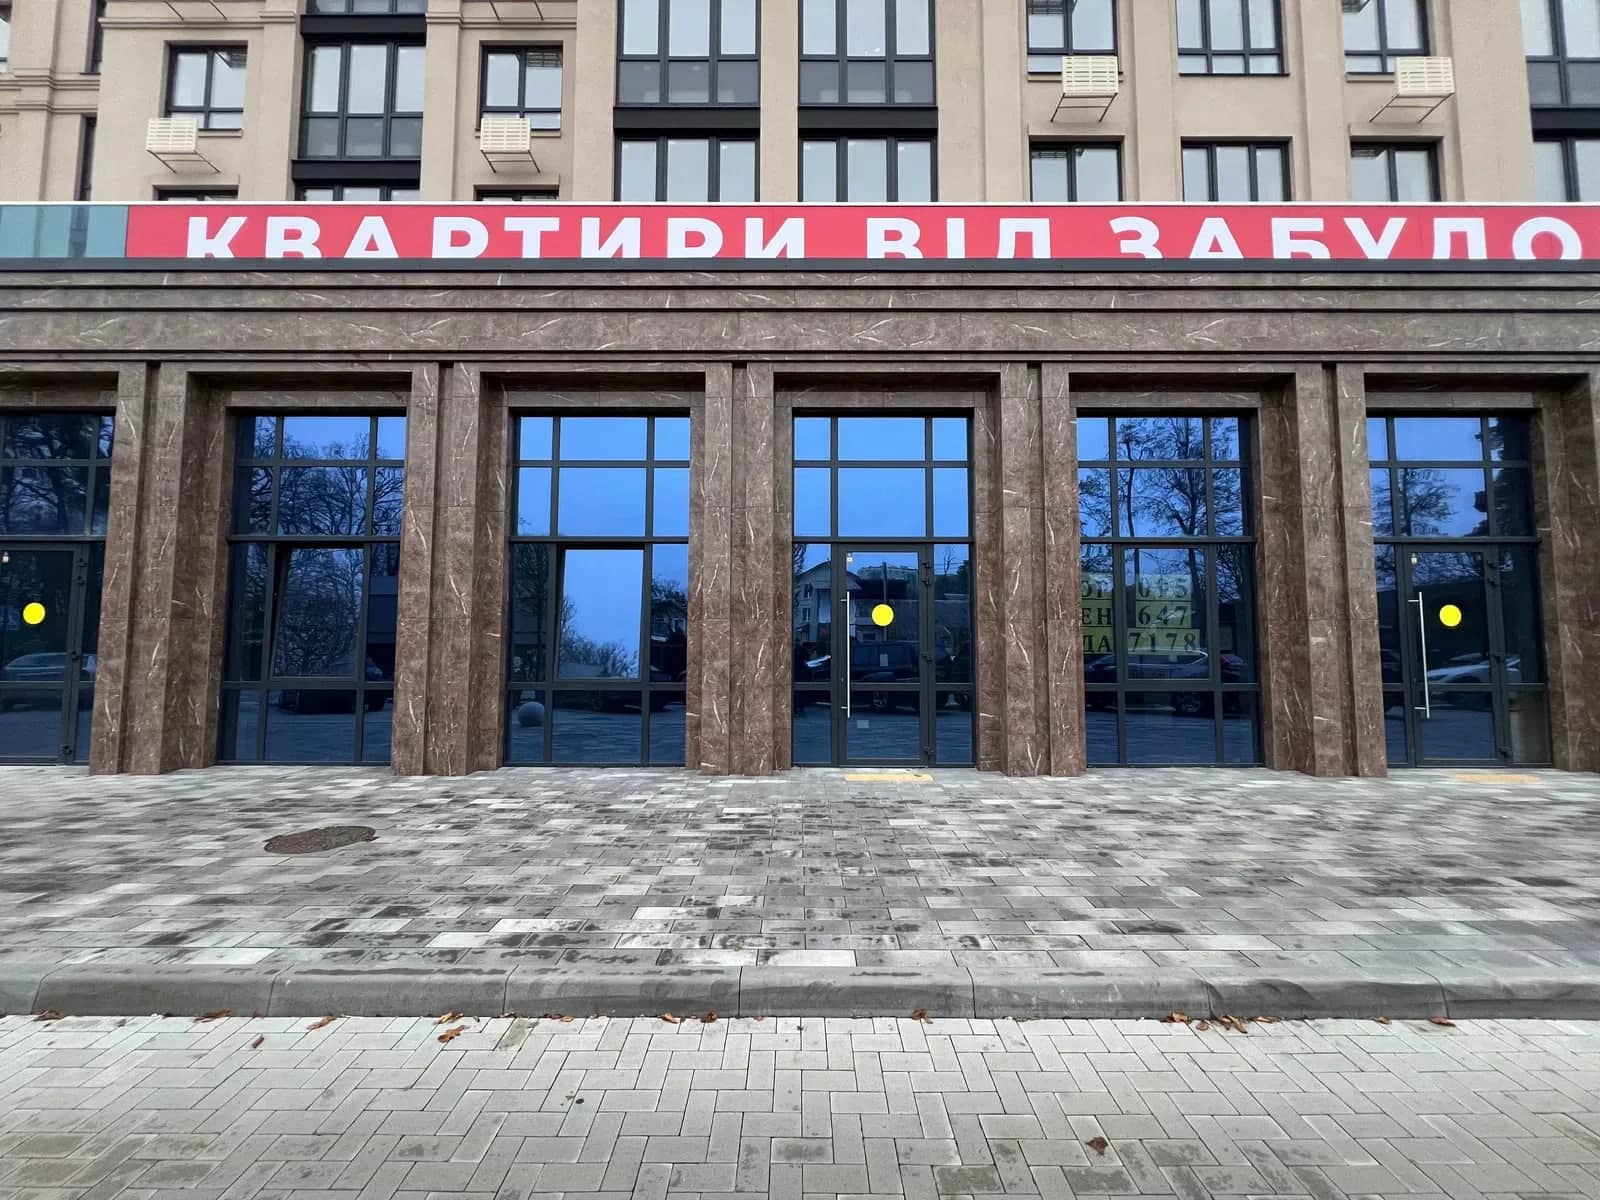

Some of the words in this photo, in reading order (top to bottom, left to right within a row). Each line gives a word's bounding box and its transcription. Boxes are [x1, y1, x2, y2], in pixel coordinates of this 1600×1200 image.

[186, 216, 805, 258] КВАРТИРИ
[1138, 605, 1187, 626] 647
[1129, 632, 1196, 653] 7178
